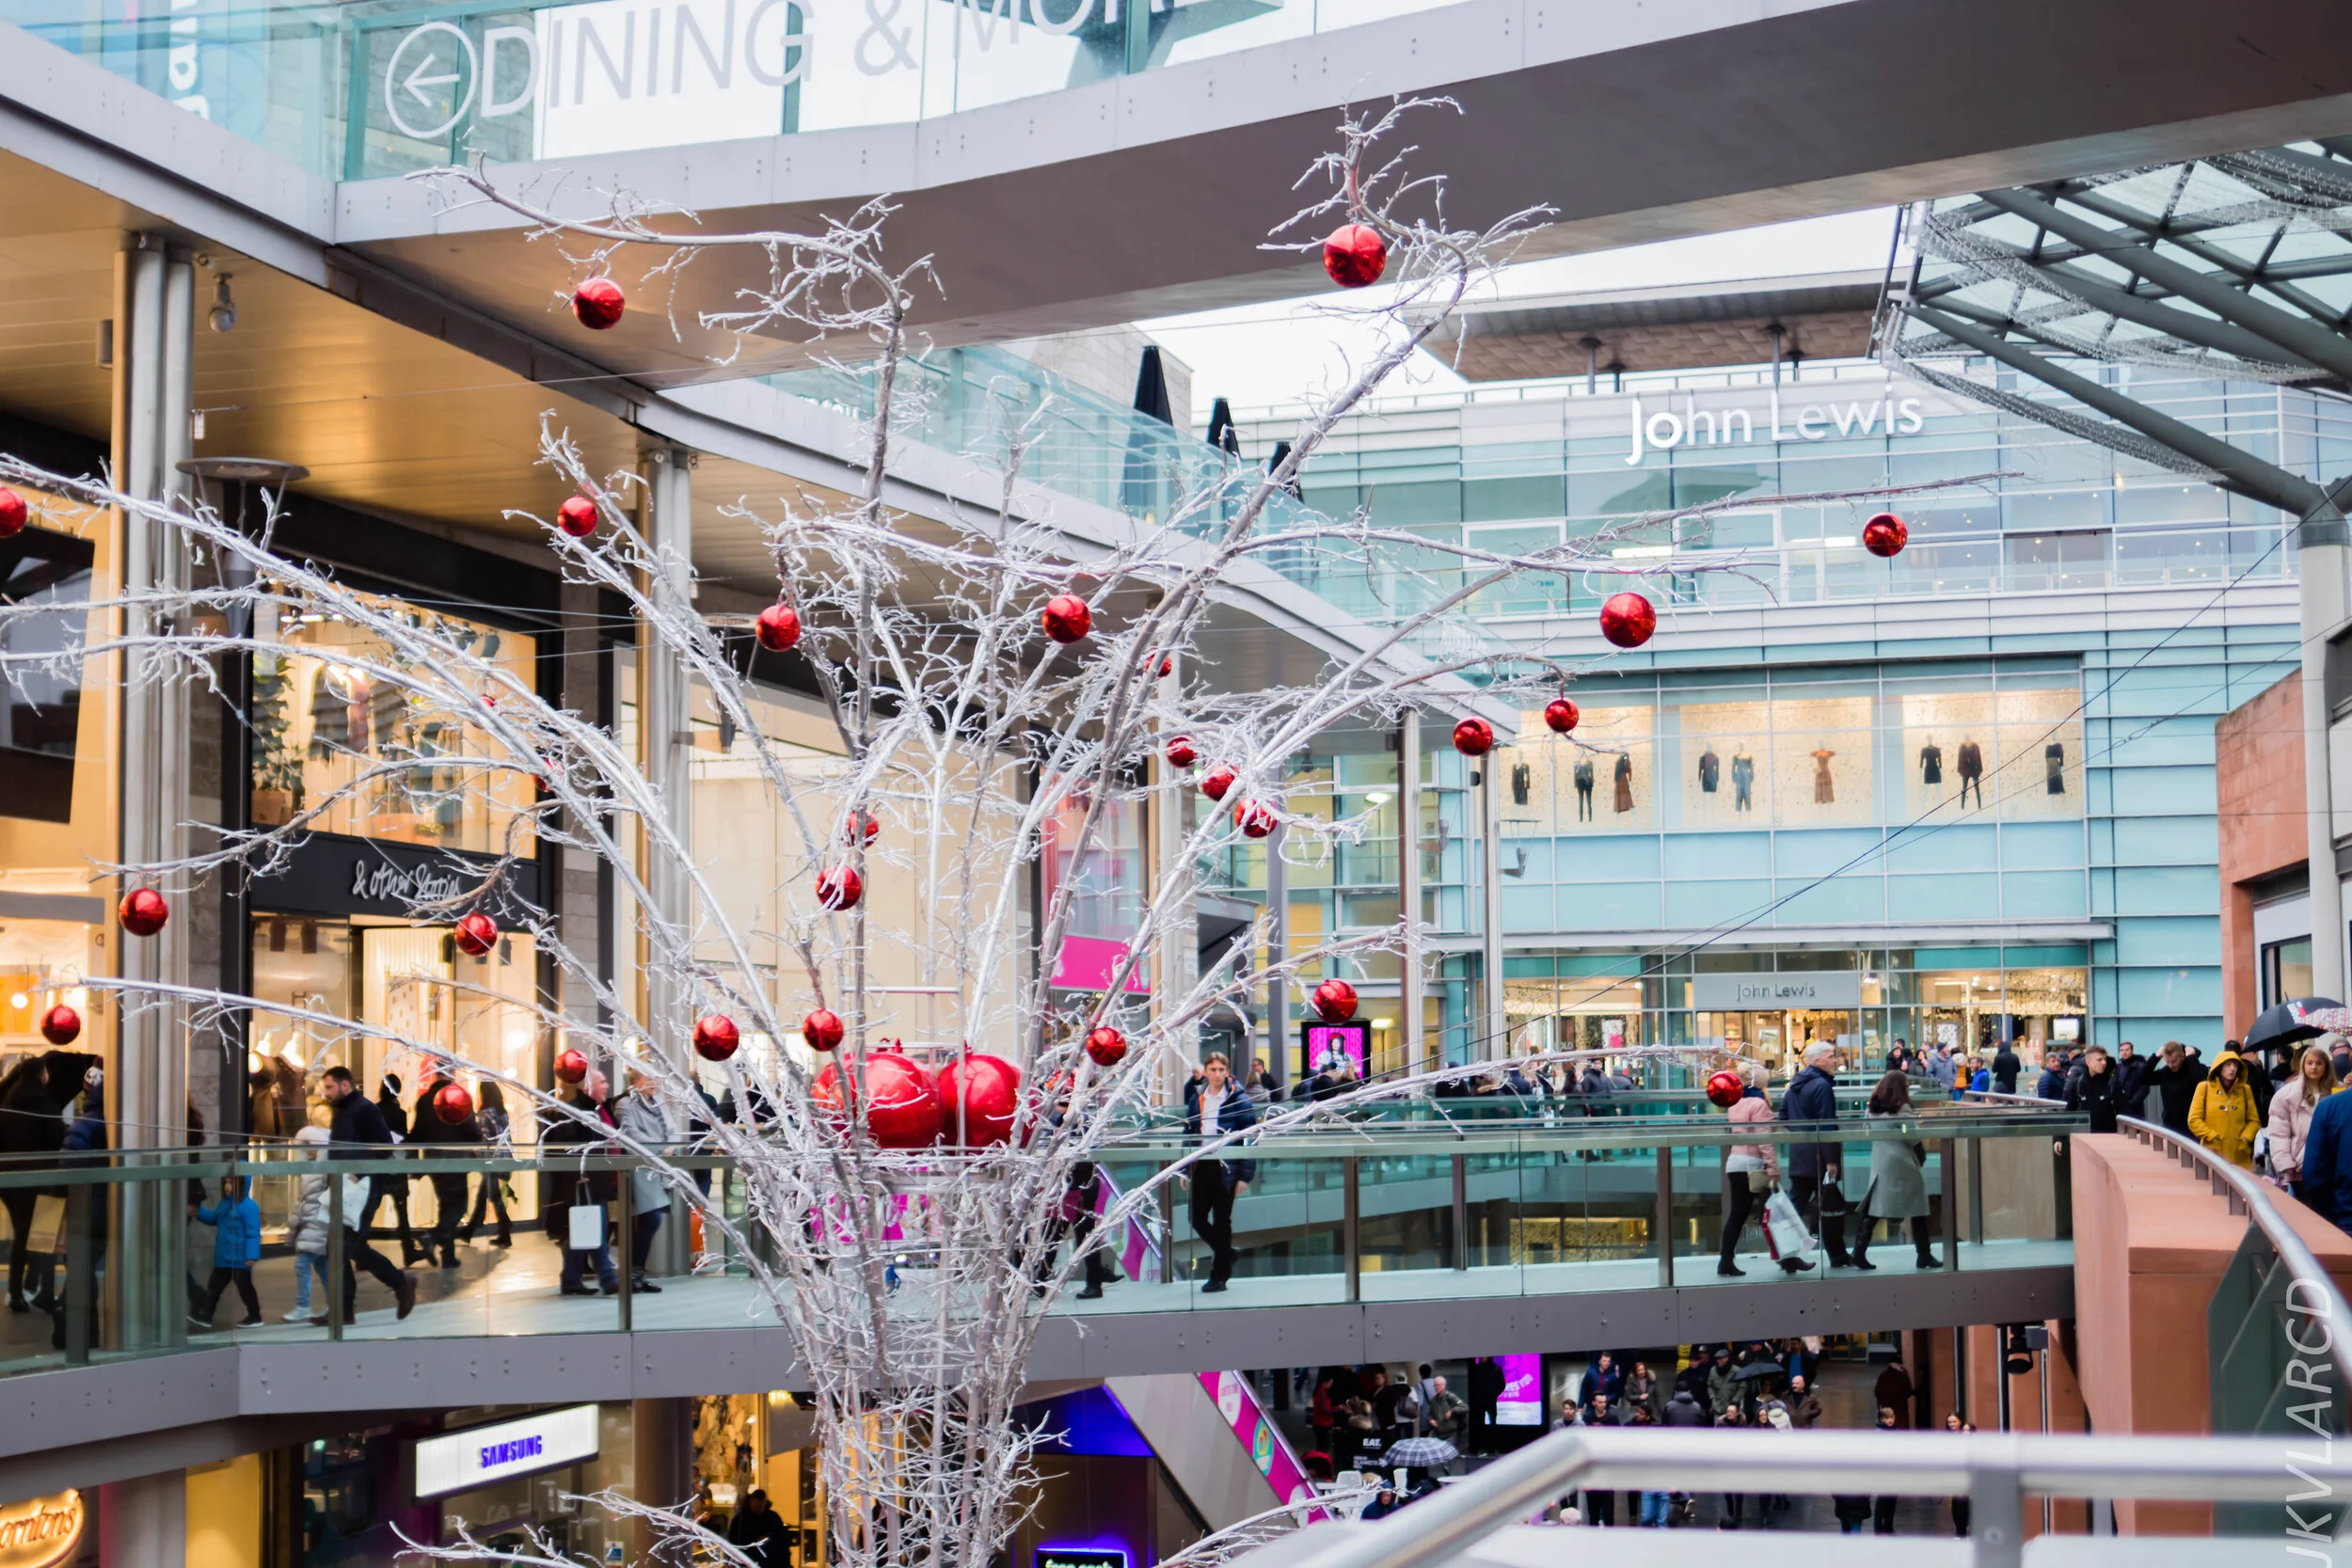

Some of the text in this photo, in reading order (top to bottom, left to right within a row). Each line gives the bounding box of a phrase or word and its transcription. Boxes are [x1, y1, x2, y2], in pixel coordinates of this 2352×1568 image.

[481, 0, 815, 118] DINING
[854, 0, 920, 76] &
[1625, 383, 1924, 466] John Lewis
[352, 860, 369, 899] &
[370, 862, 414, 900] other
[1737, 982, 1816, 1002] John Lewis
[480, 1434, 543, 1469] SAMSUNG
[1362, 1437, 1382, 1448] EAT.
